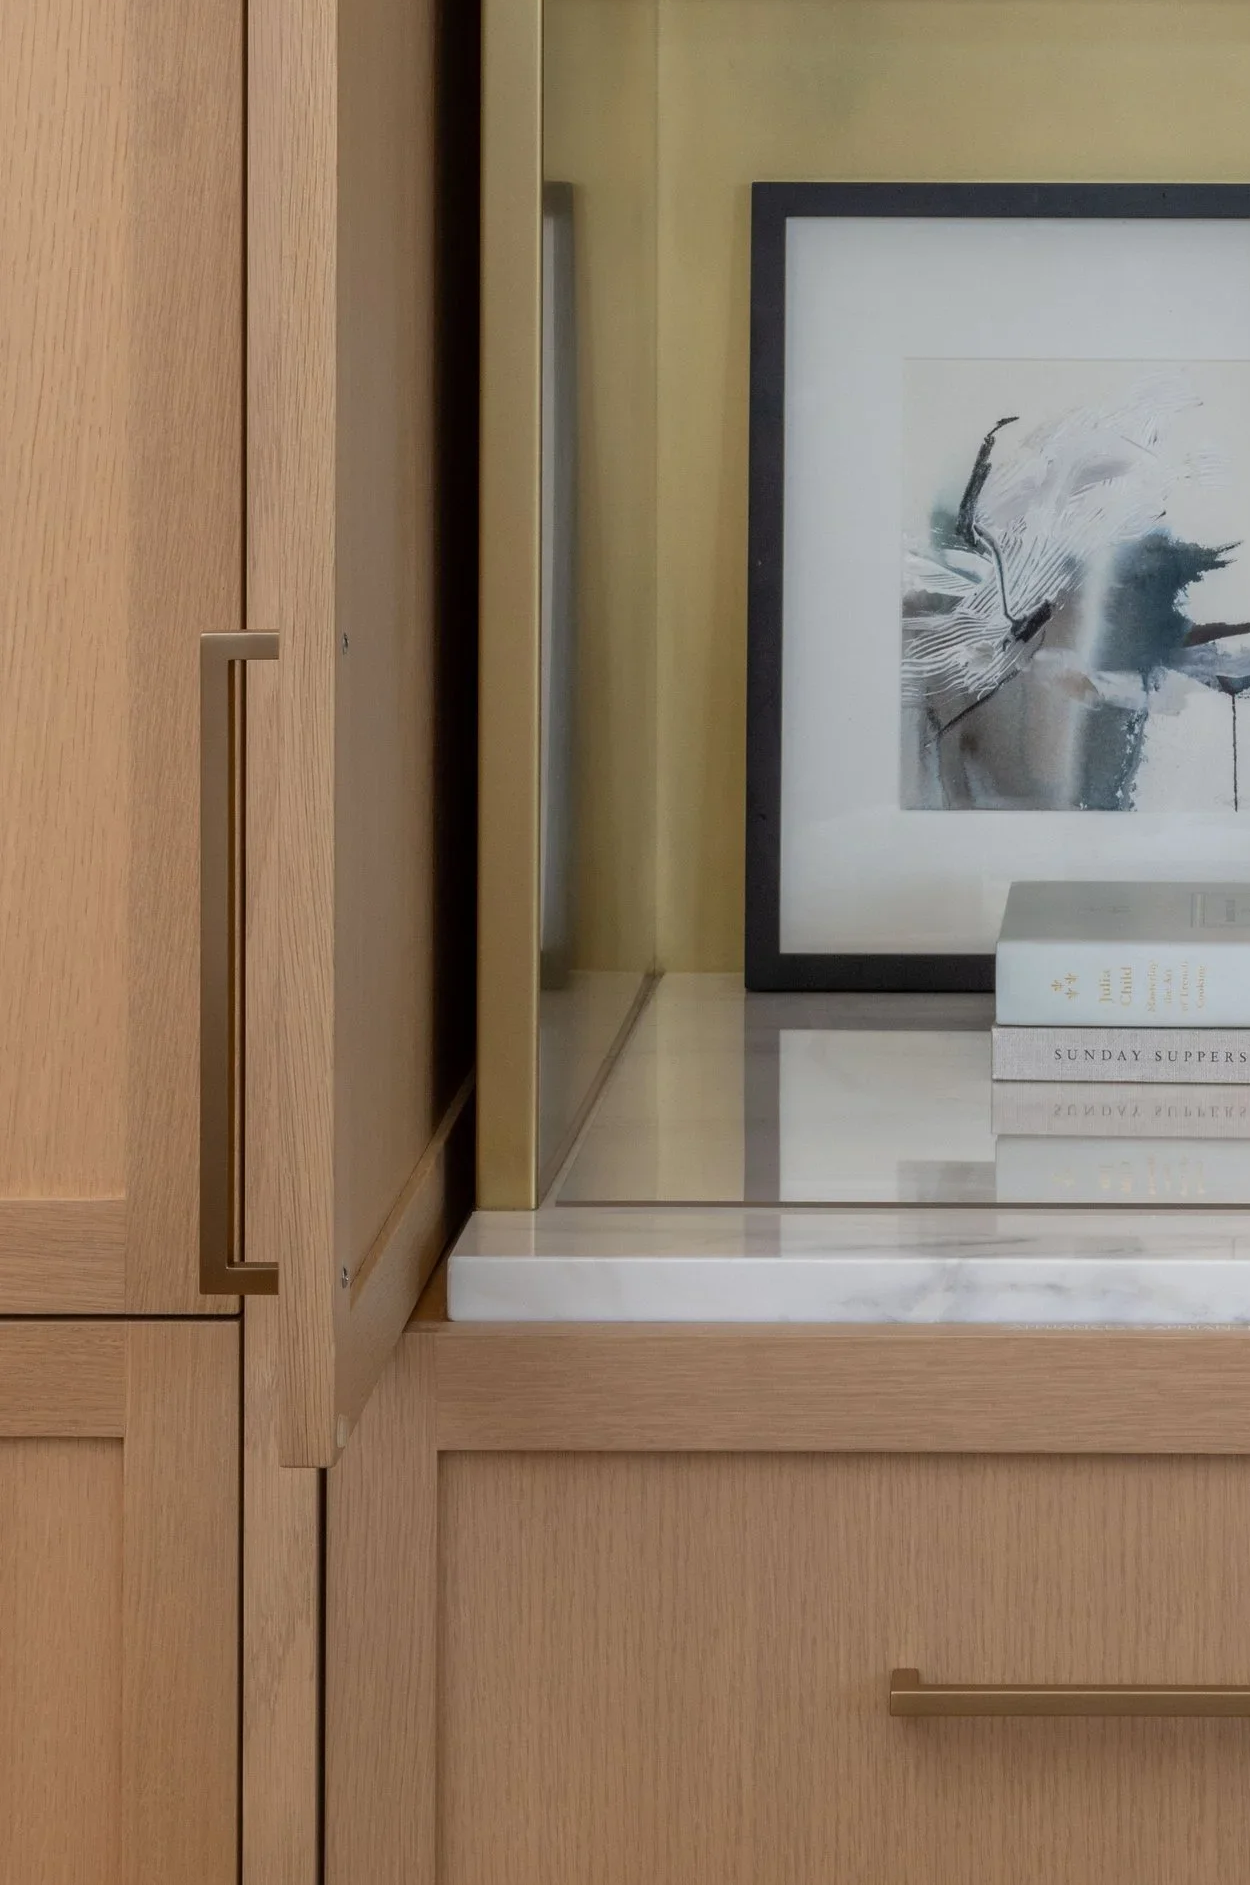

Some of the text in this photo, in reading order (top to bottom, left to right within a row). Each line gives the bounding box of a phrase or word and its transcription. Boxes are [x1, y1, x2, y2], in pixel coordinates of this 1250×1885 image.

[1098, 969, 1113, 1004] Julia
[1120, 966, 1132, 1006] Child
[1053, 1048, 1248, 1064] SUNDAY SUPPERS
